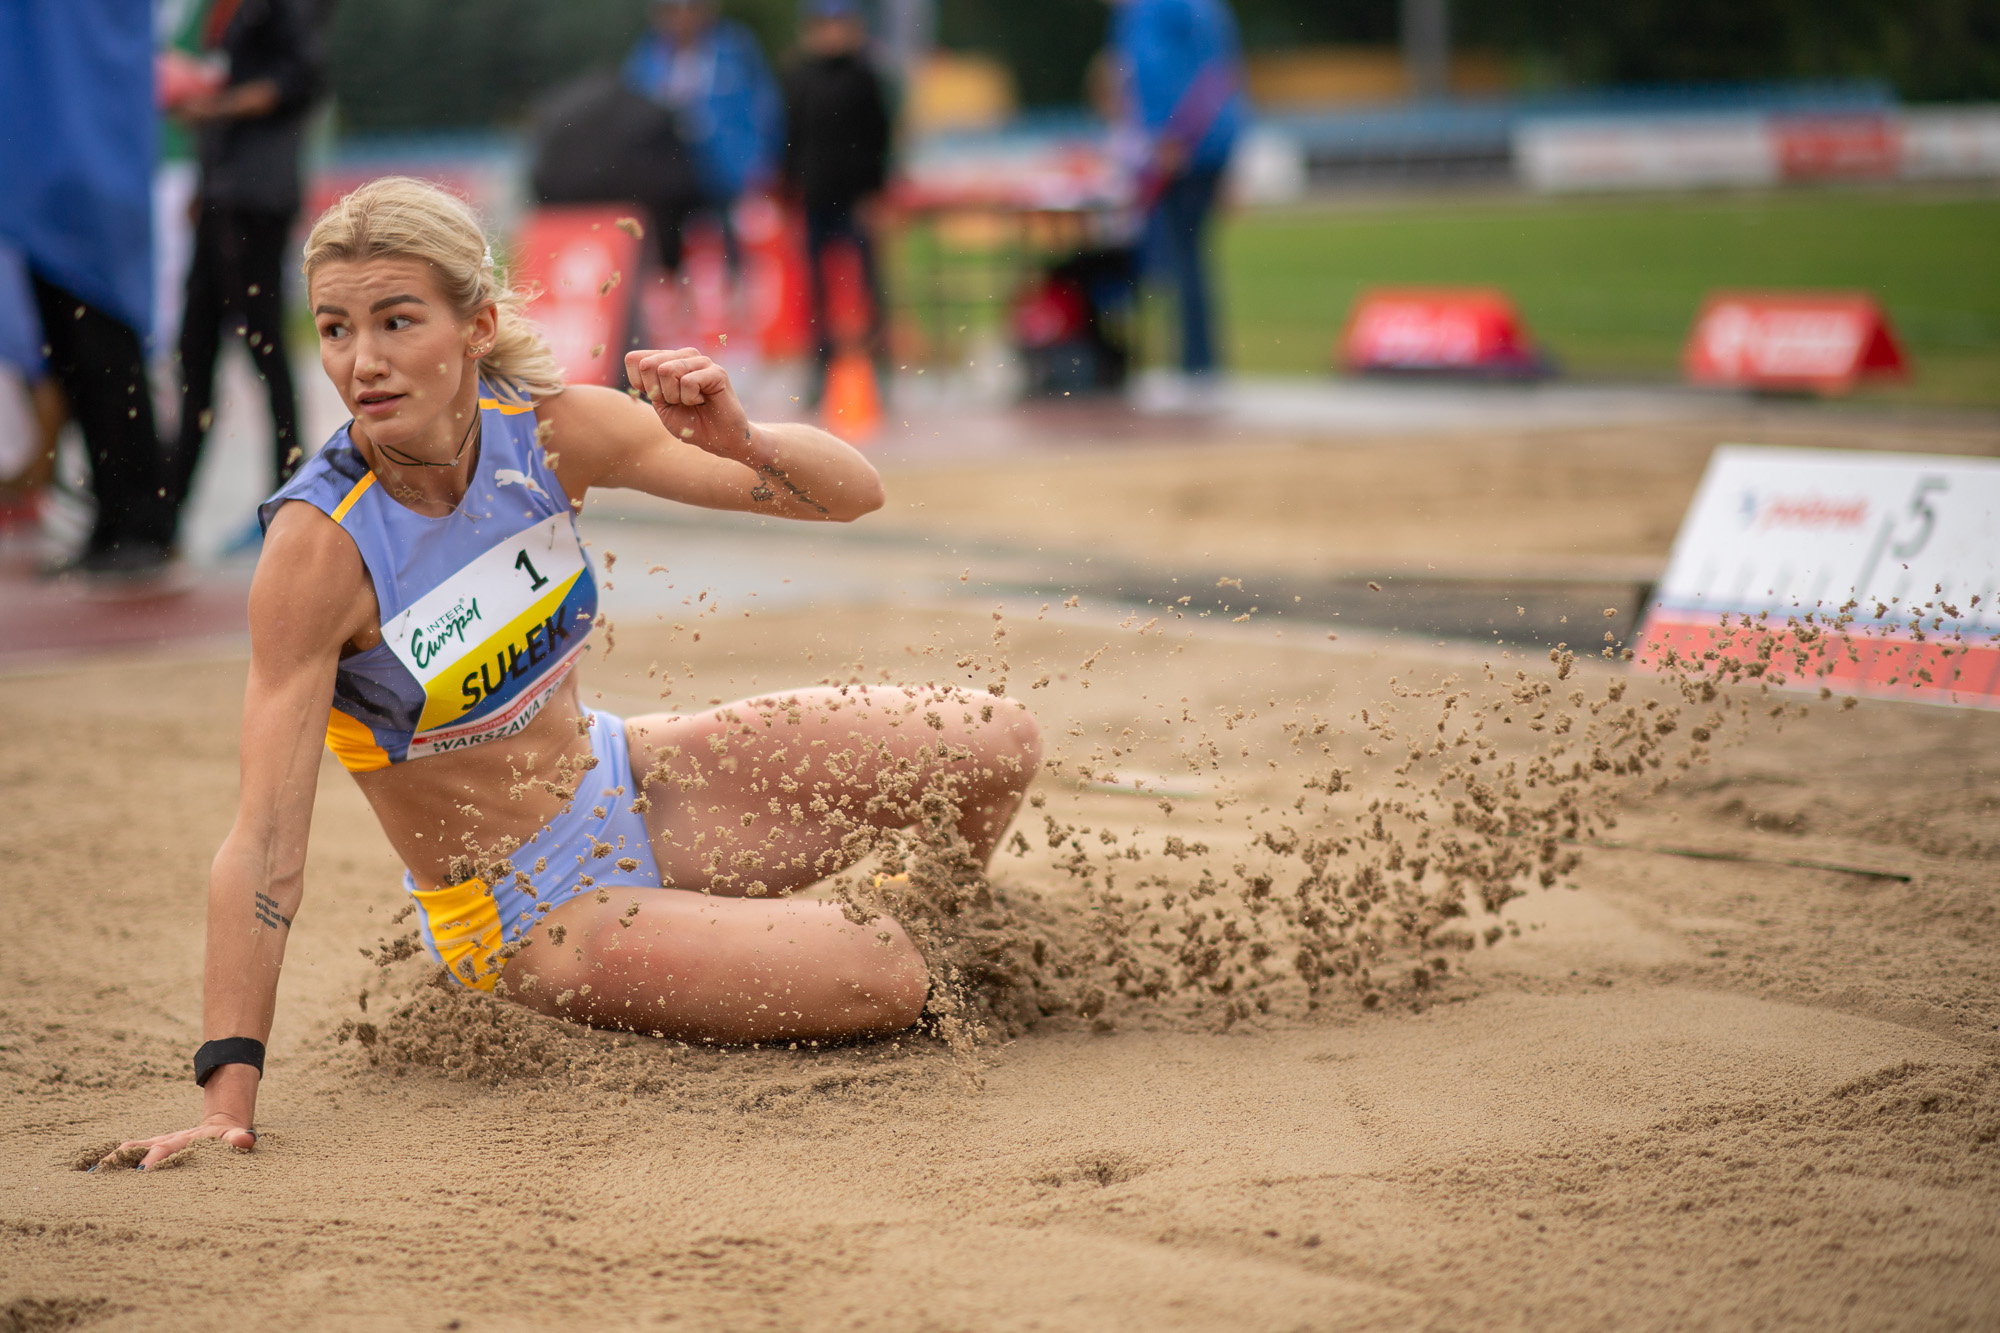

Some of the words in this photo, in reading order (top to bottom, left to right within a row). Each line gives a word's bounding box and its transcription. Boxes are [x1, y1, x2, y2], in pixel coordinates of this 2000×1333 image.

[1893, 474, 1949, 559] 5
[514, 549, 549, 592] 1
[411, 597, 482, 669] Europol
[427, 604, 464, 633] INTER
[461, 604, 570, 711] SUŁEK
[433, 699, 540, 752] WARSZAWA
